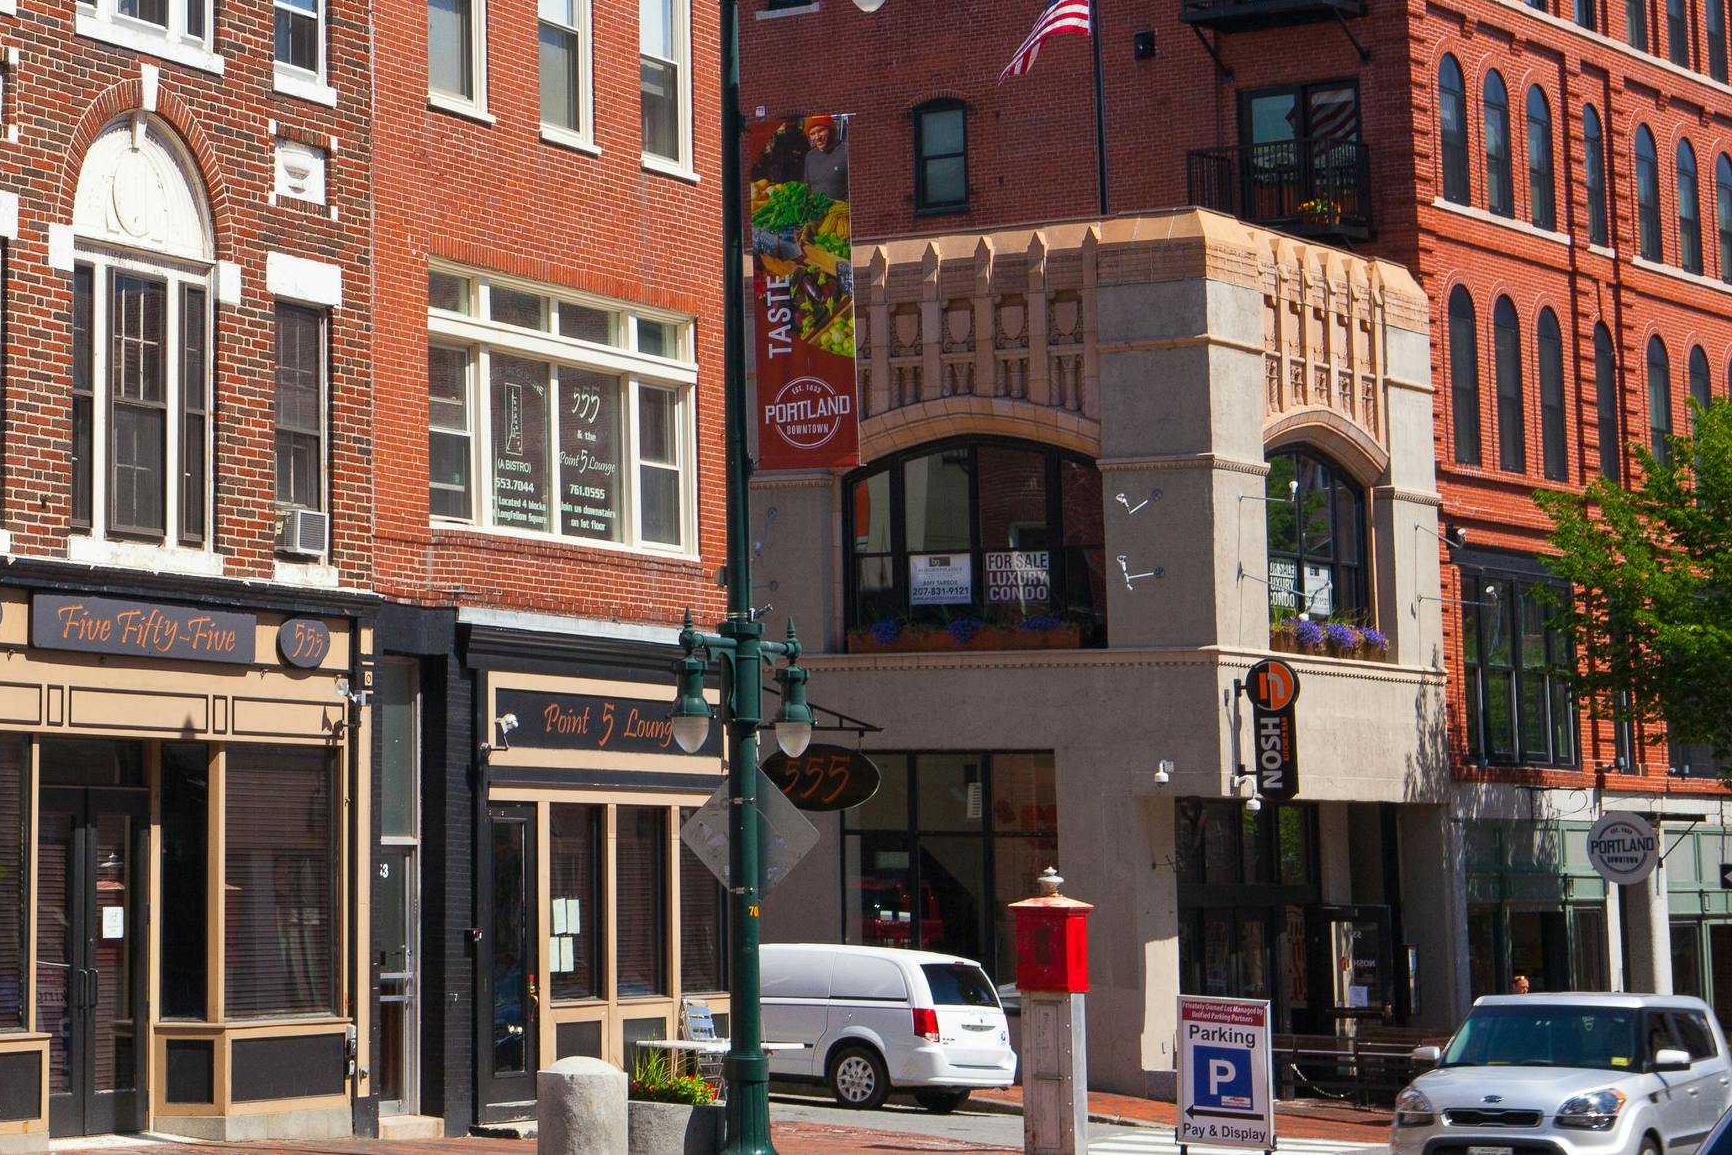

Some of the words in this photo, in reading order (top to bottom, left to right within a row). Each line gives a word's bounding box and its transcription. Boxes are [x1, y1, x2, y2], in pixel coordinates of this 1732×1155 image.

[766, 274, 792, 359] TASTE
[571, 385, 601, 424] 555
[765, 395, 851, 424] PORTLAND
[577, 430, 583, 439] &
[585, 431, 596, 442] the
[786, 422, 829, 436] DOWNTOWN
[498, 458, 505, 470] (A
[506, 460, 532, 473] BISTRO)
[560, 451, 580, 467] Point
[579, 449, 588, 474] 5
[588, 456, 616, 476] Lounge
[496, 477, 534, 493] 553.7044
[570, 484, 605, 500] 761.0555
[499, 496, 521, 507] Located
[522, 499, 527, 508] 4
[528, 500, 546, 511] blocks
[498, 508, 527, 521] Longfellow
[574, 506, 582, 514] us
[583, 505, 616, 519] downstairs
[571, 519, 579, 527] on
[580, 518, 589, 529] 1st
[591, 520, 605, 531] floor
[988, 554, 1012, 569] FOR
[1015, 553, 1047, 568] SALE
[989, 571, 1048, 586] LUXURY
[1270, 576, 1295, 592] UXURY
[913, 587, 968, 596] 207-831-9121
[990, 587, 1047, 601] CONDO
[1270, 591, 1296, 607] ONDO
[57, 604, 111, 642] Five
[117, 608, 237, 651] Fifty-Five
[291, 623, 324, 658] 555
[544, 703, 590, 734] Point
[598, 702, 616, 746] 5
[624, 707, 674, 748] Loung
[1260, 717, 1283, 788] NOSH
[781, 755, 851, 804] 555
[1591, 837, 1654, 855] PORTLAND
[1607, 856, 1639, 864] DOWNTOWN
[1192, 1011, 1210, 1019] Unified
[1211, 1013, 1230, 1022] Parking
[1231, 1014, 1253, 1022] Partners
[1233, 1006, 1256, 1015] Managed
[1257, 1008, 1263, 1016] by
[1189, 1024, 1256, 1048] Parking
[1209, 1058, 1236, 1095] P
[1183, 1123, 1205, 1138] Pay
[1209, 1124, 1217, 1136] &
[1222, 1126, 1266, 1142] Display
